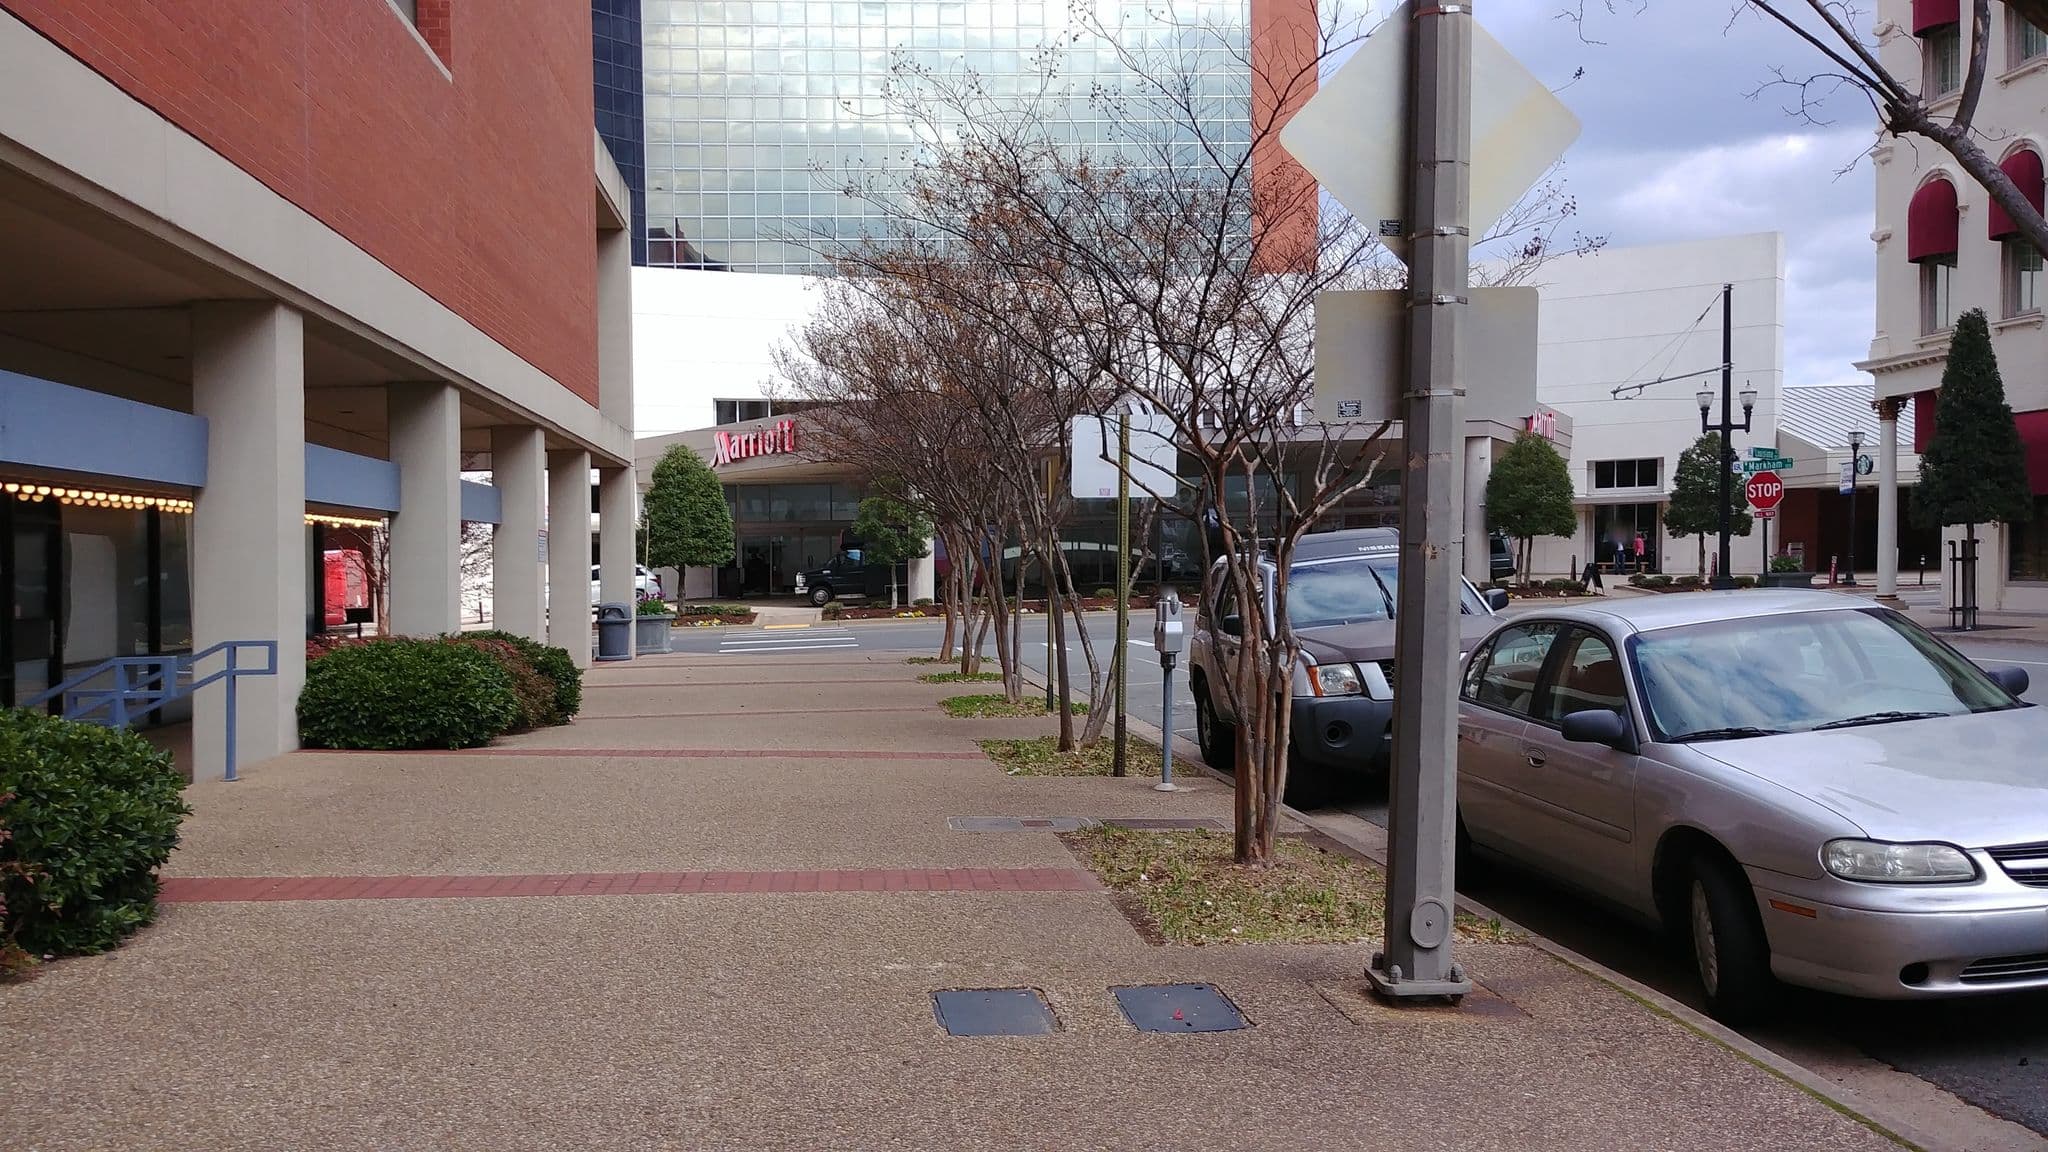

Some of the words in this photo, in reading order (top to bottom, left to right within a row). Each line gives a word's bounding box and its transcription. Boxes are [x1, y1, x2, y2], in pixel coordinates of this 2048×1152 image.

[710, 418, 795, 468] Marriott
[1749, 461, 1783, 471] Markham
[1748, 483, 1781, 498] STOP
